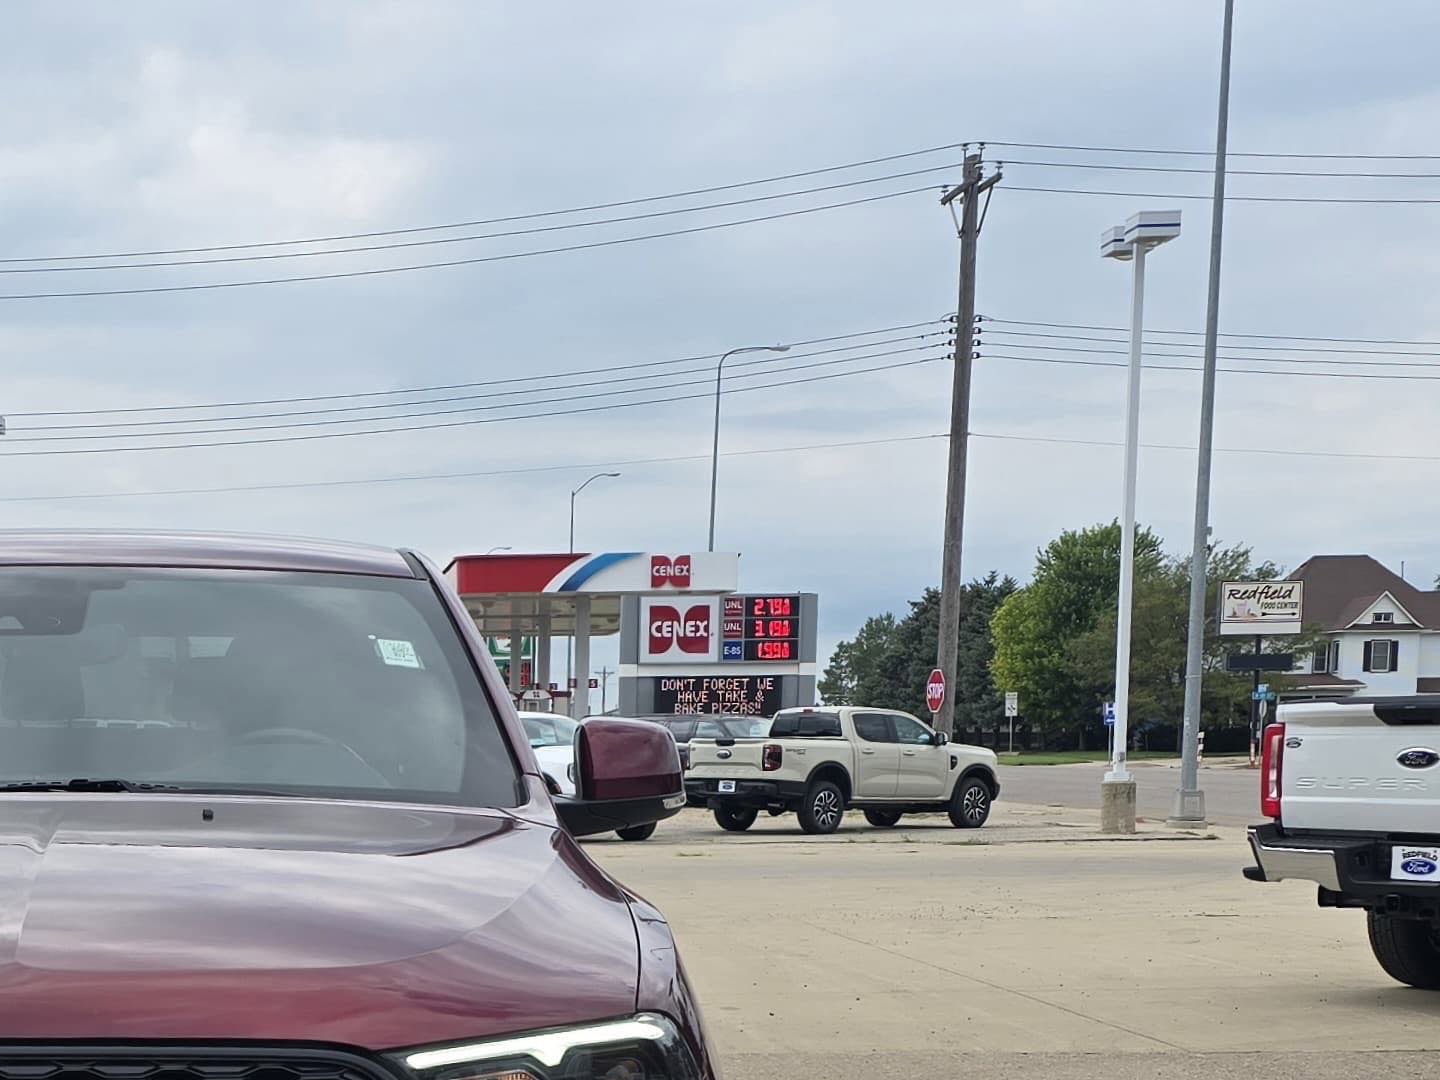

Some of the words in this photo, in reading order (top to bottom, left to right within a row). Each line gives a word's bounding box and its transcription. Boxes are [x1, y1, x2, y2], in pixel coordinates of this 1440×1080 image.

[652, 565, 689, 577] CENEX
[1227, 585, 1295, 604] Redfield
[724, 600, 743, 609] UNL
[650, 620, 709, 638] CENEX
[724, 623, 742, 631] UNL
[723, 646, 741, 655] E-85
[661, 679, 696, 690] DON'T
[703, 678, 750, 690] FORGET
[757, 678, 774, 690] WE
[677, 690, 710, 702] HAVE
[717, 690, 748, 702] TAKE
[755, 690, 765, 702] &
[928, 683, 945, 699] STOP
[674, 702, 704, 714] BAKE
[1404, 751, 1430, 765] Ford
[1295, 777, 1429, 791] SUPER
[1406, 861, 1431, 873] Ford
